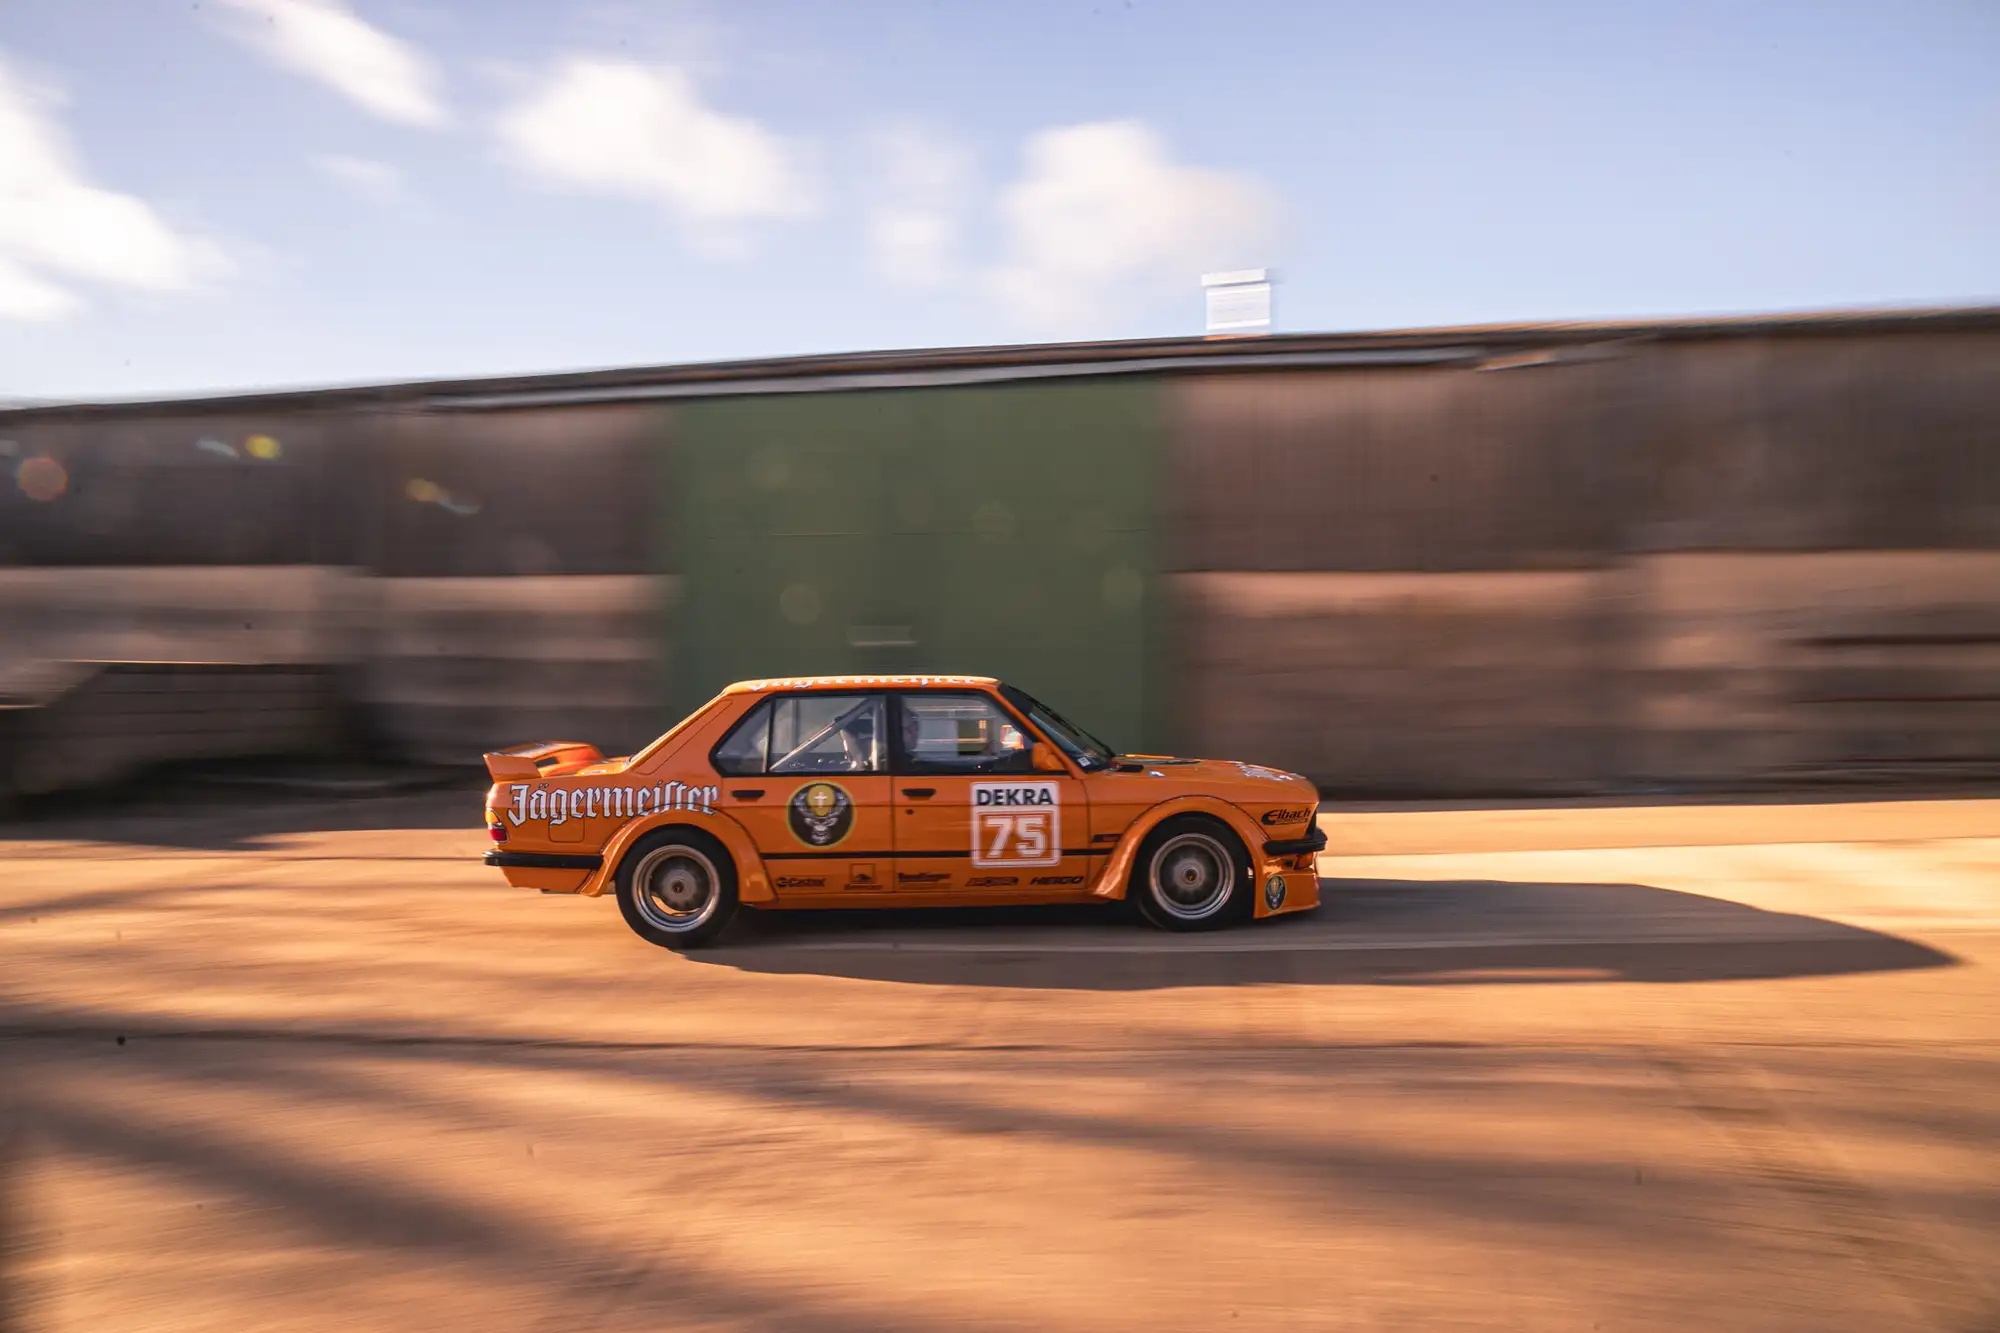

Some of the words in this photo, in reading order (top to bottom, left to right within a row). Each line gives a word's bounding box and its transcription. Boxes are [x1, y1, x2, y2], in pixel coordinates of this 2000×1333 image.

[507, 780, 719, 828] Jägermeister
[976, 788, 1054, 806] DEKRA
[985, 815, 1046, 858] 75
